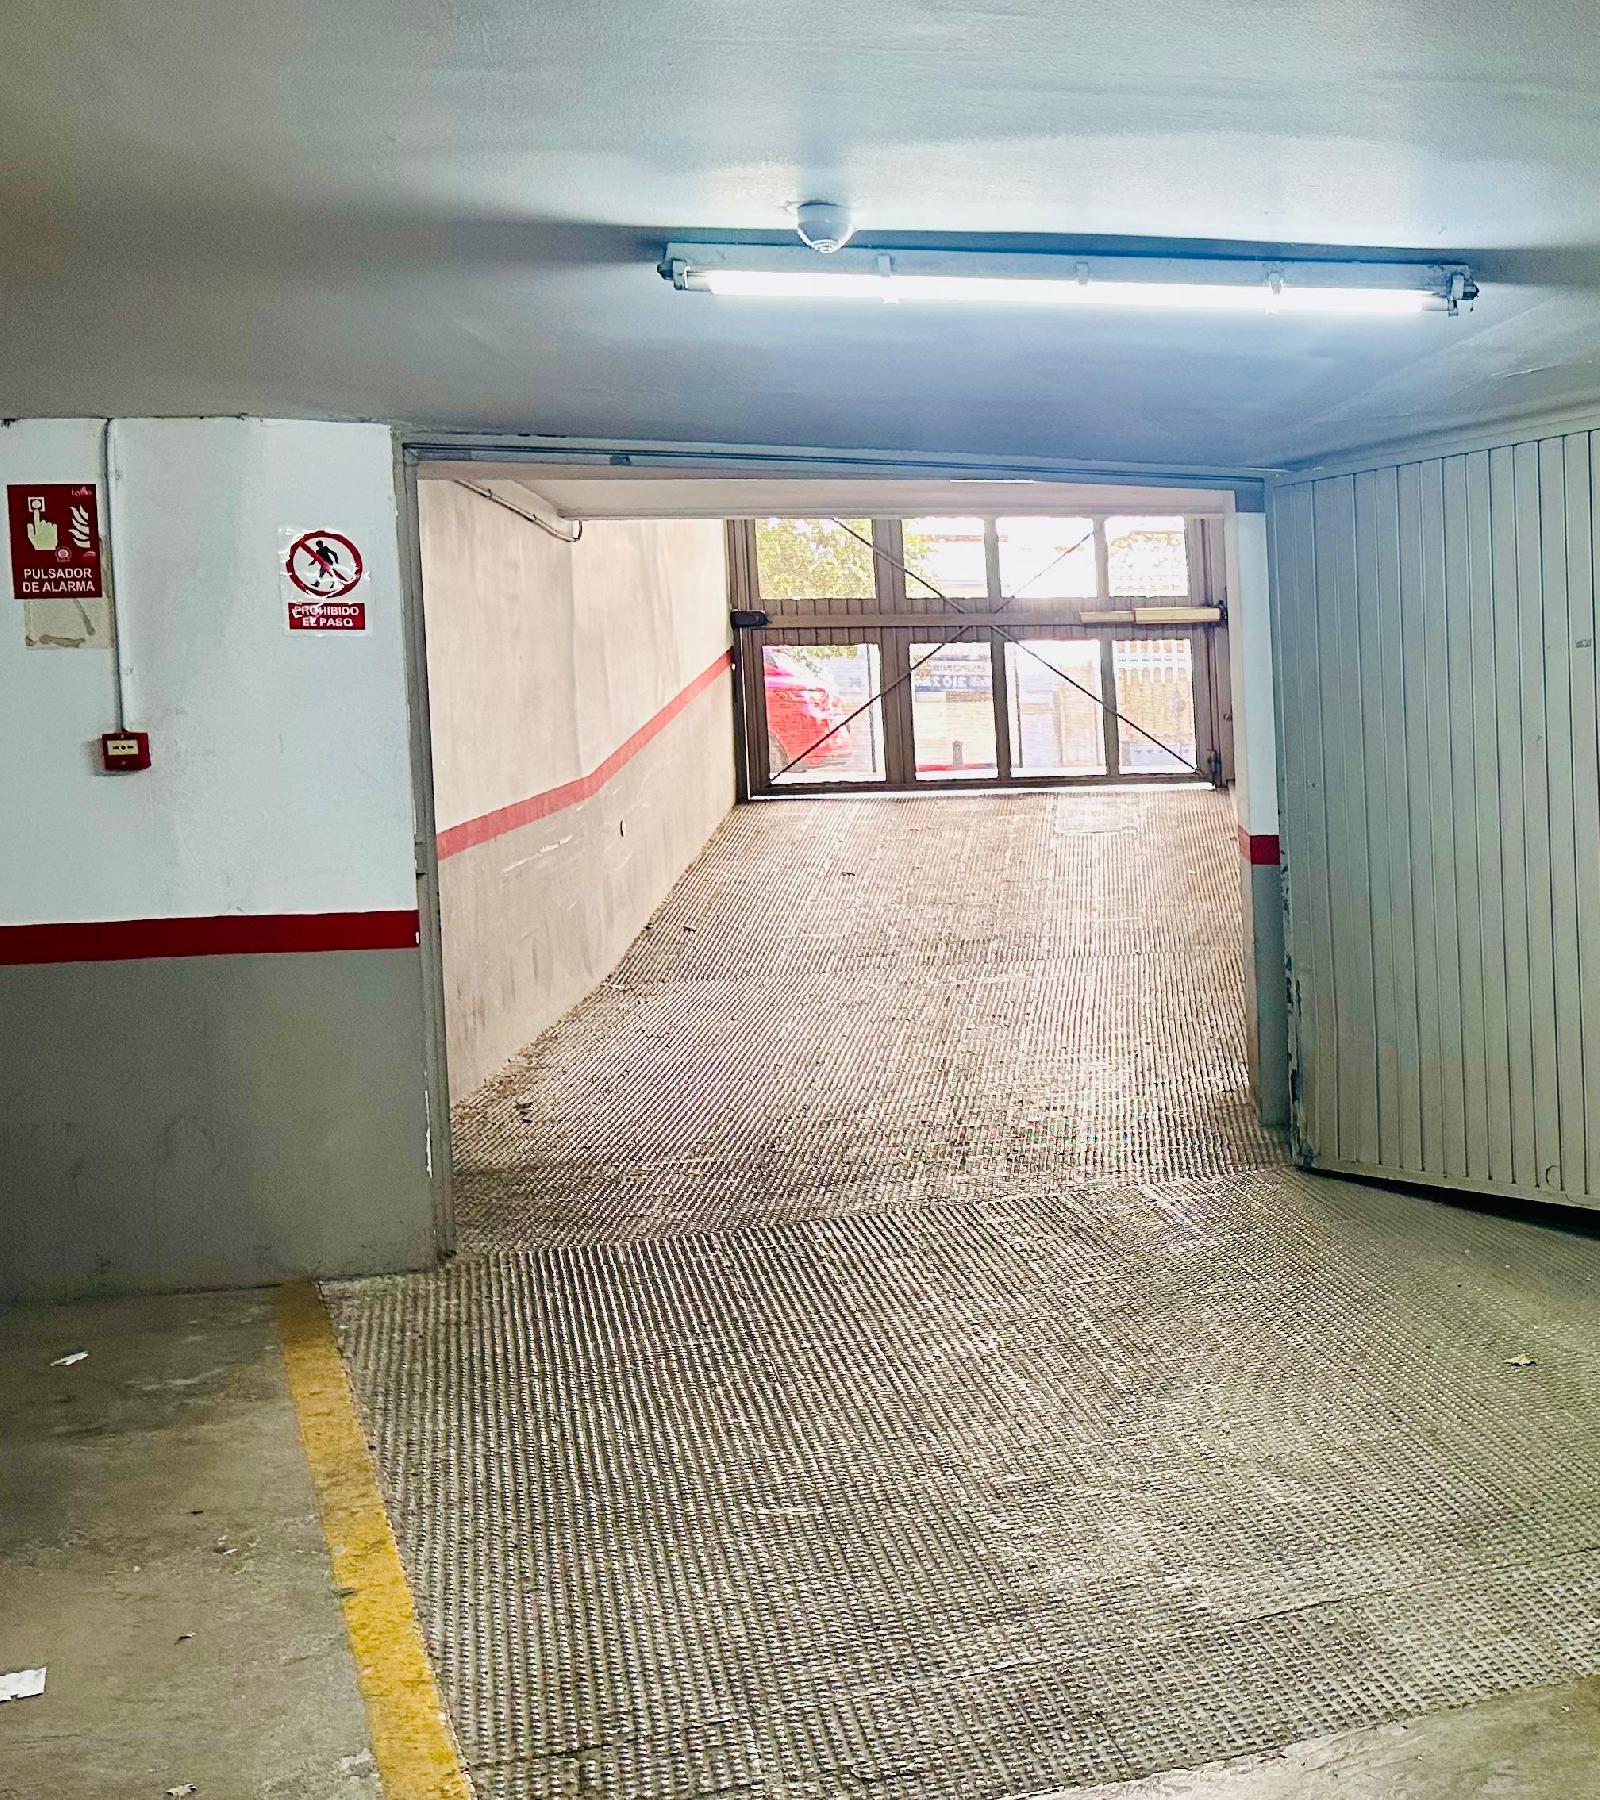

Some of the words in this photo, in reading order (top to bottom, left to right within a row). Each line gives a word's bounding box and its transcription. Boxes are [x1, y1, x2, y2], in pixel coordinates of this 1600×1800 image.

[23, 568, 93, 579] PULSADOR
[22, 582, 40, 593] DE
[42, 580, 96, 593] ALARMA
[293, 605, 359, 616] PROHIBIDO
[302, 617, 317, 627] EL
[319, 617, 354, 627] PASO
